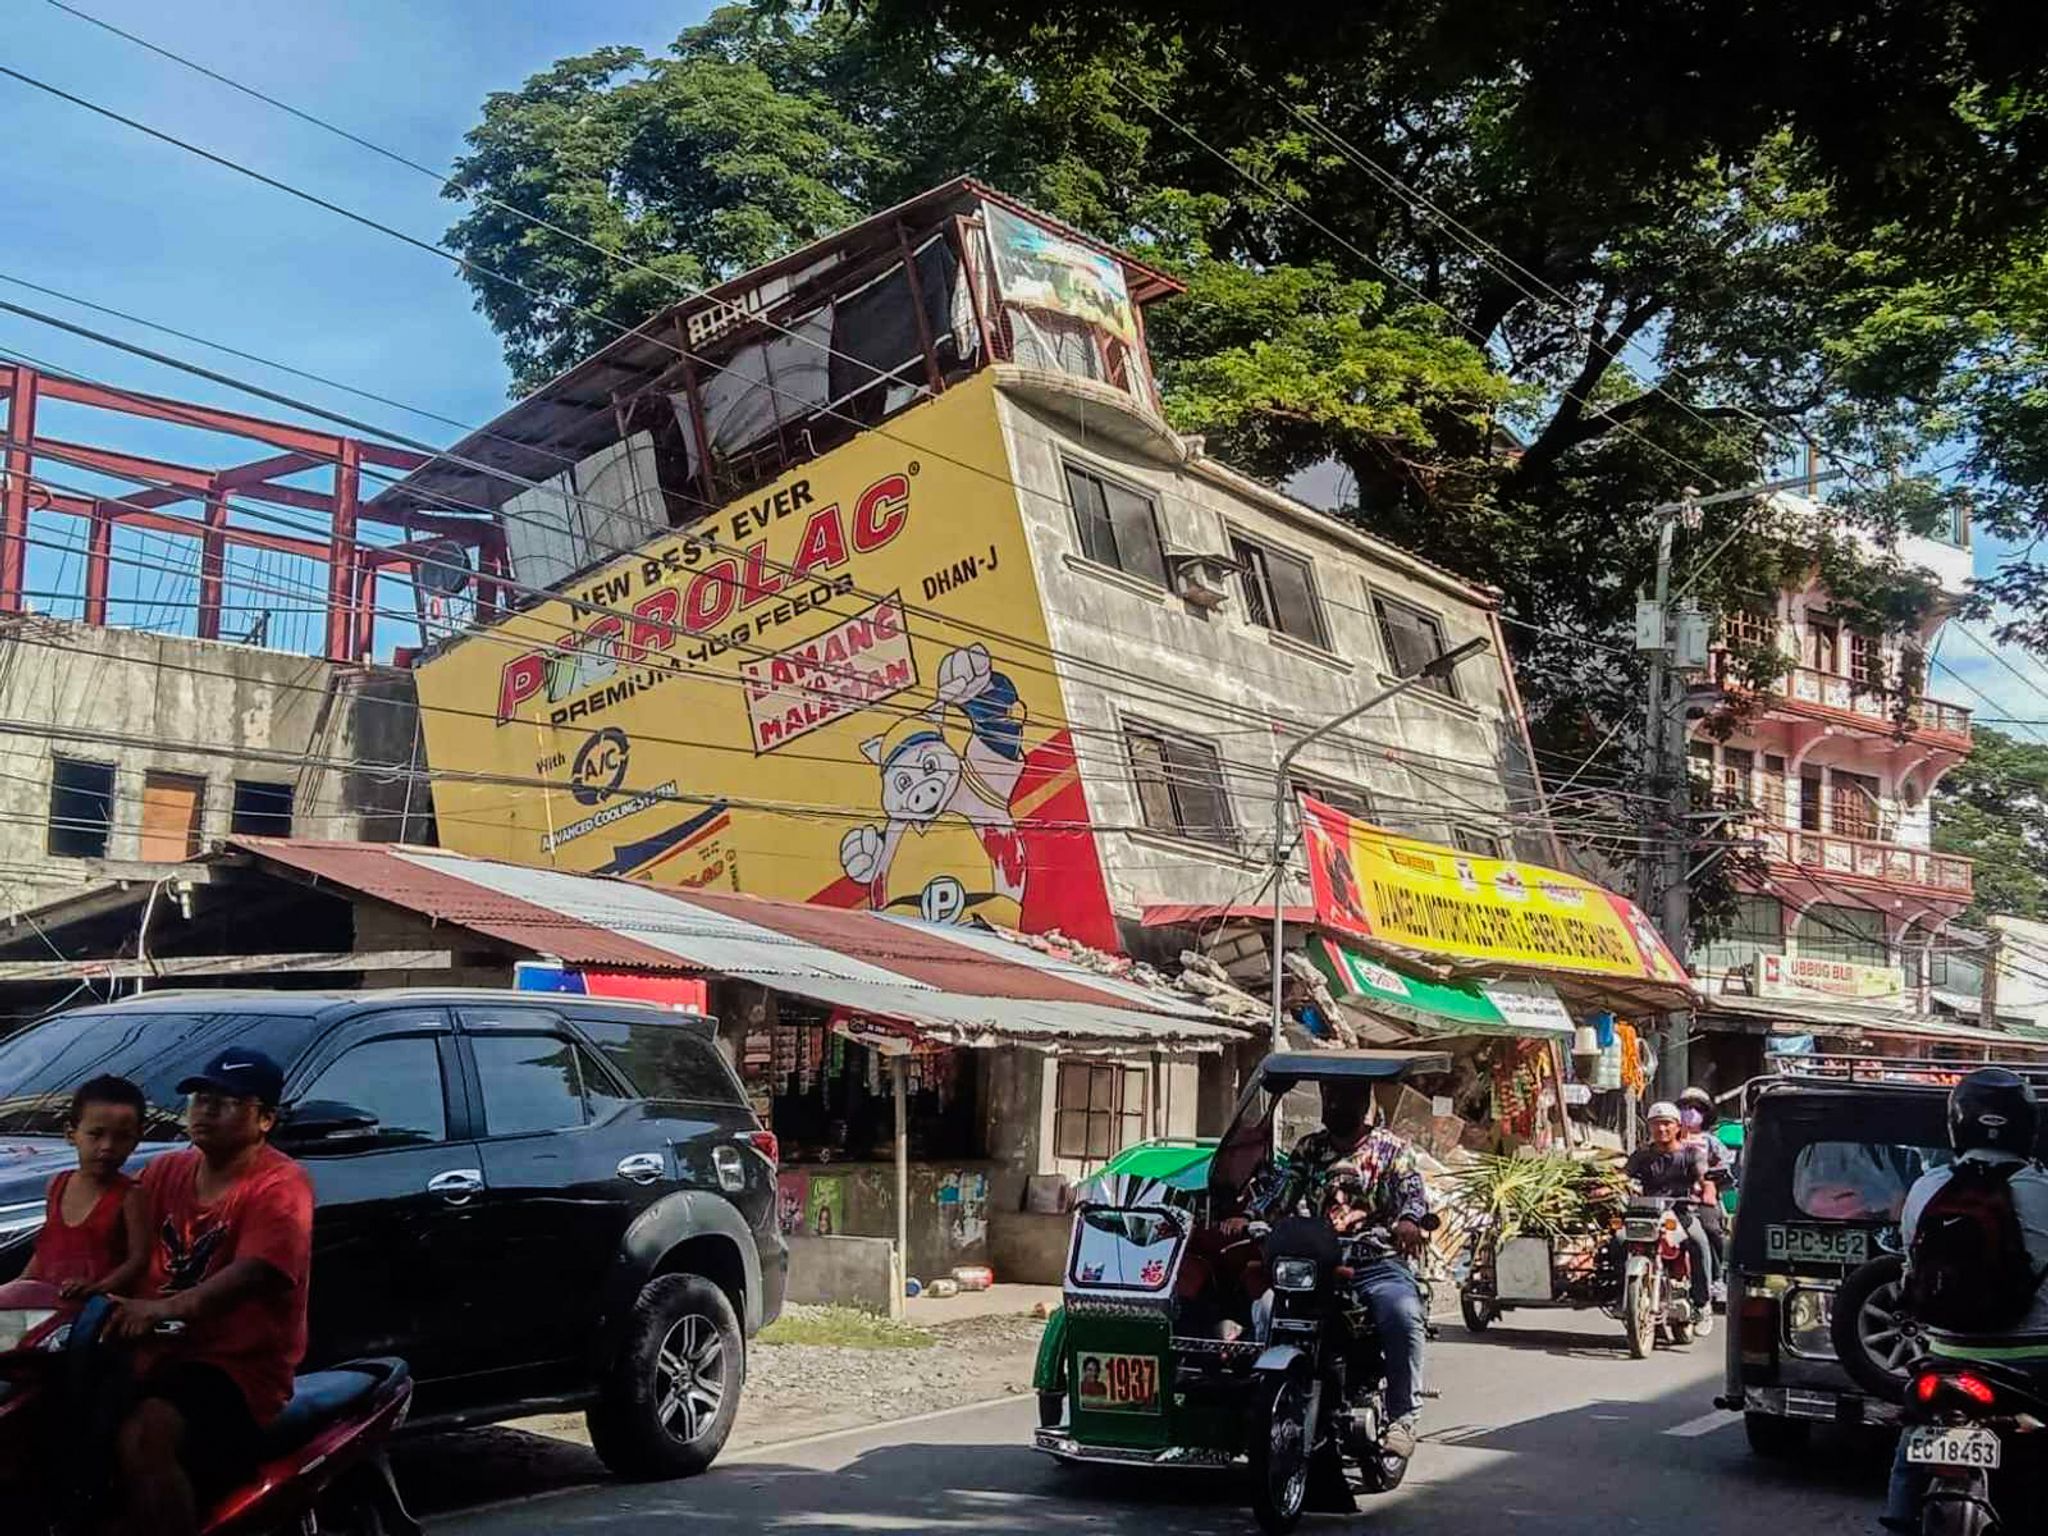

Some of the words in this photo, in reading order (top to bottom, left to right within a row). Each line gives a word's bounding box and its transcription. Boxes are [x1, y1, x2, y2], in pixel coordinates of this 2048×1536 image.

[570, 571, 631, 622] NEW
[641, 526, 720, 587] BEST
[731, 479, 814, 541] EVER
[922, 544, 998, 601] DHAN-J
[756, 574, 852, 634] FEEDS
[749, 602, 898, 701] LAMANG
[1106, 1357, 1155, 1400] 1937
[1939, 1440, 1995, 1464] 18453
